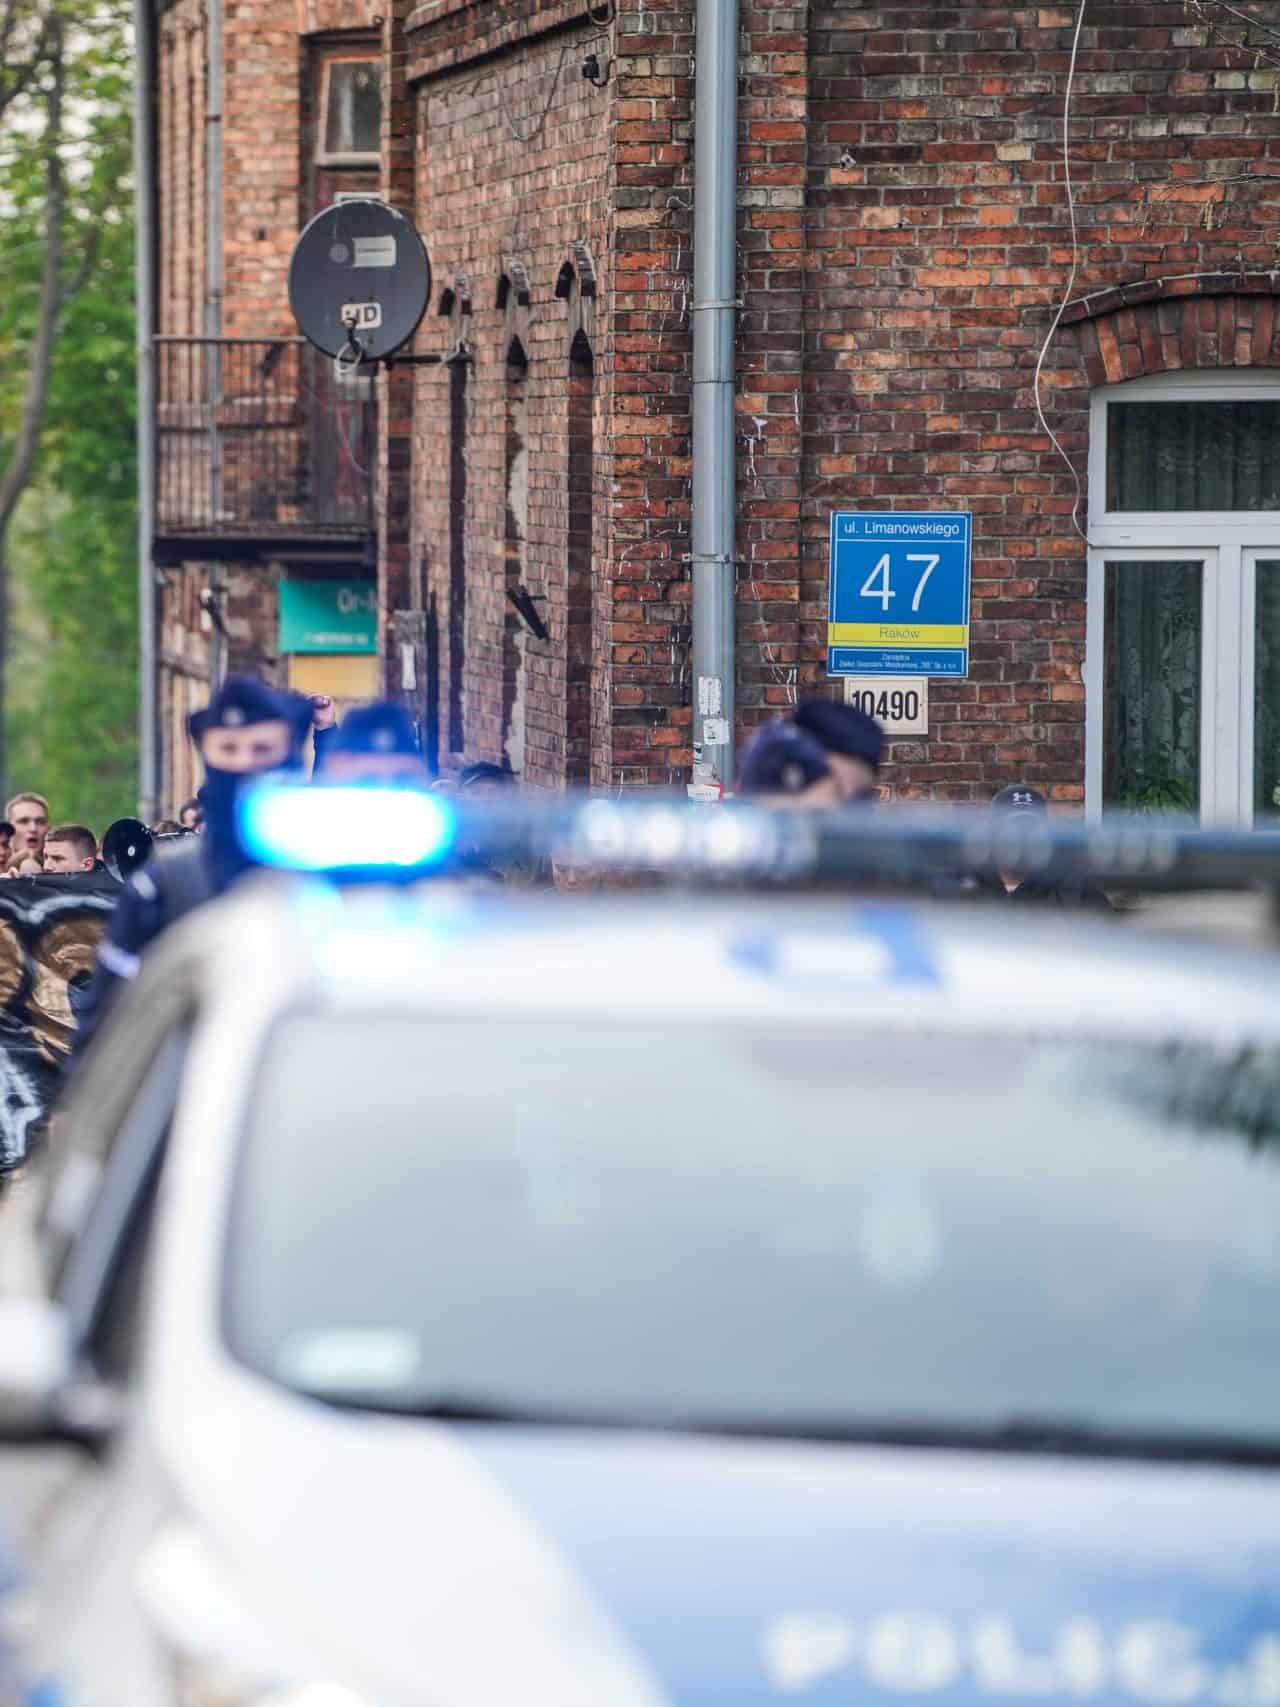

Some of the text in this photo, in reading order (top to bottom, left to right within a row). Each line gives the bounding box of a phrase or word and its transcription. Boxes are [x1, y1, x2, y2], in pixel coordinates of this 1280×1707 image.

[844, 522, 960, 537] ul. Limanowskiego
[860, 553, 940, 612] 47
[879, 627, 921, 639] Raków
[852, 690, 919, 721] 10490
